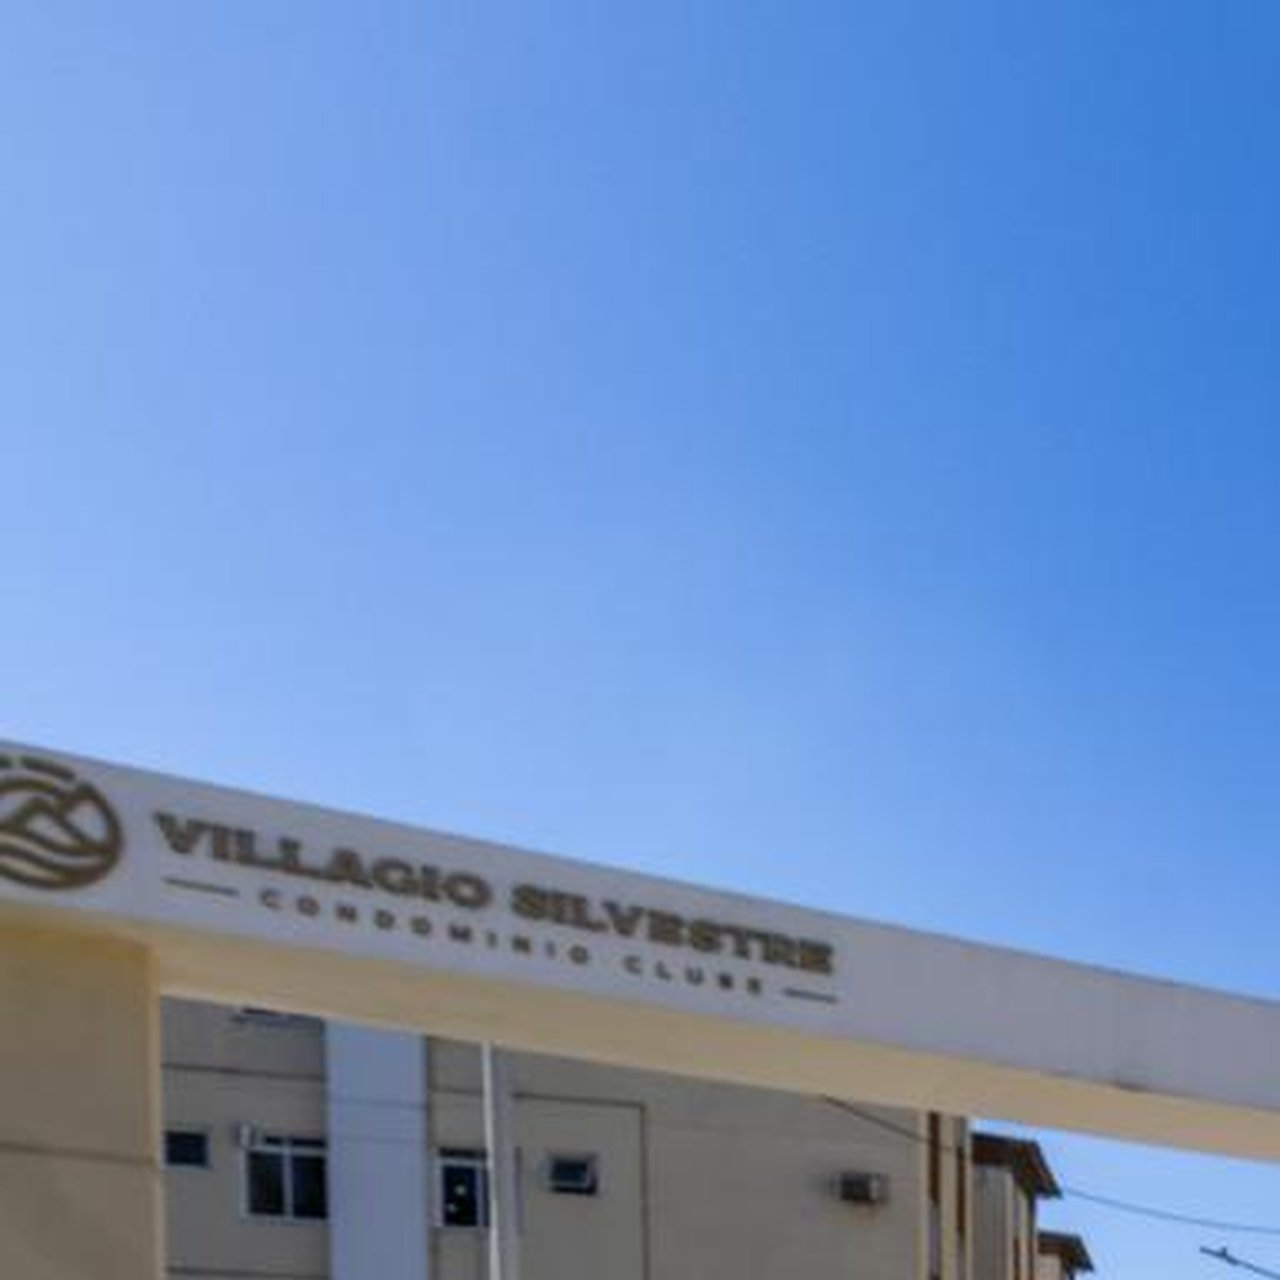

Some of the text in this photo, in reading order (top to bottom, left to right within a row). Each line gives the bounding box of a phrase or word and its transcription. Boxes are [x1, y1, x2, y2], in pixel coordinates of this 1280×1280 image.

[154, 812, 834, 974] VILLAGIO SILVESTRE
[624, 956, 763, 995] CLUBE
